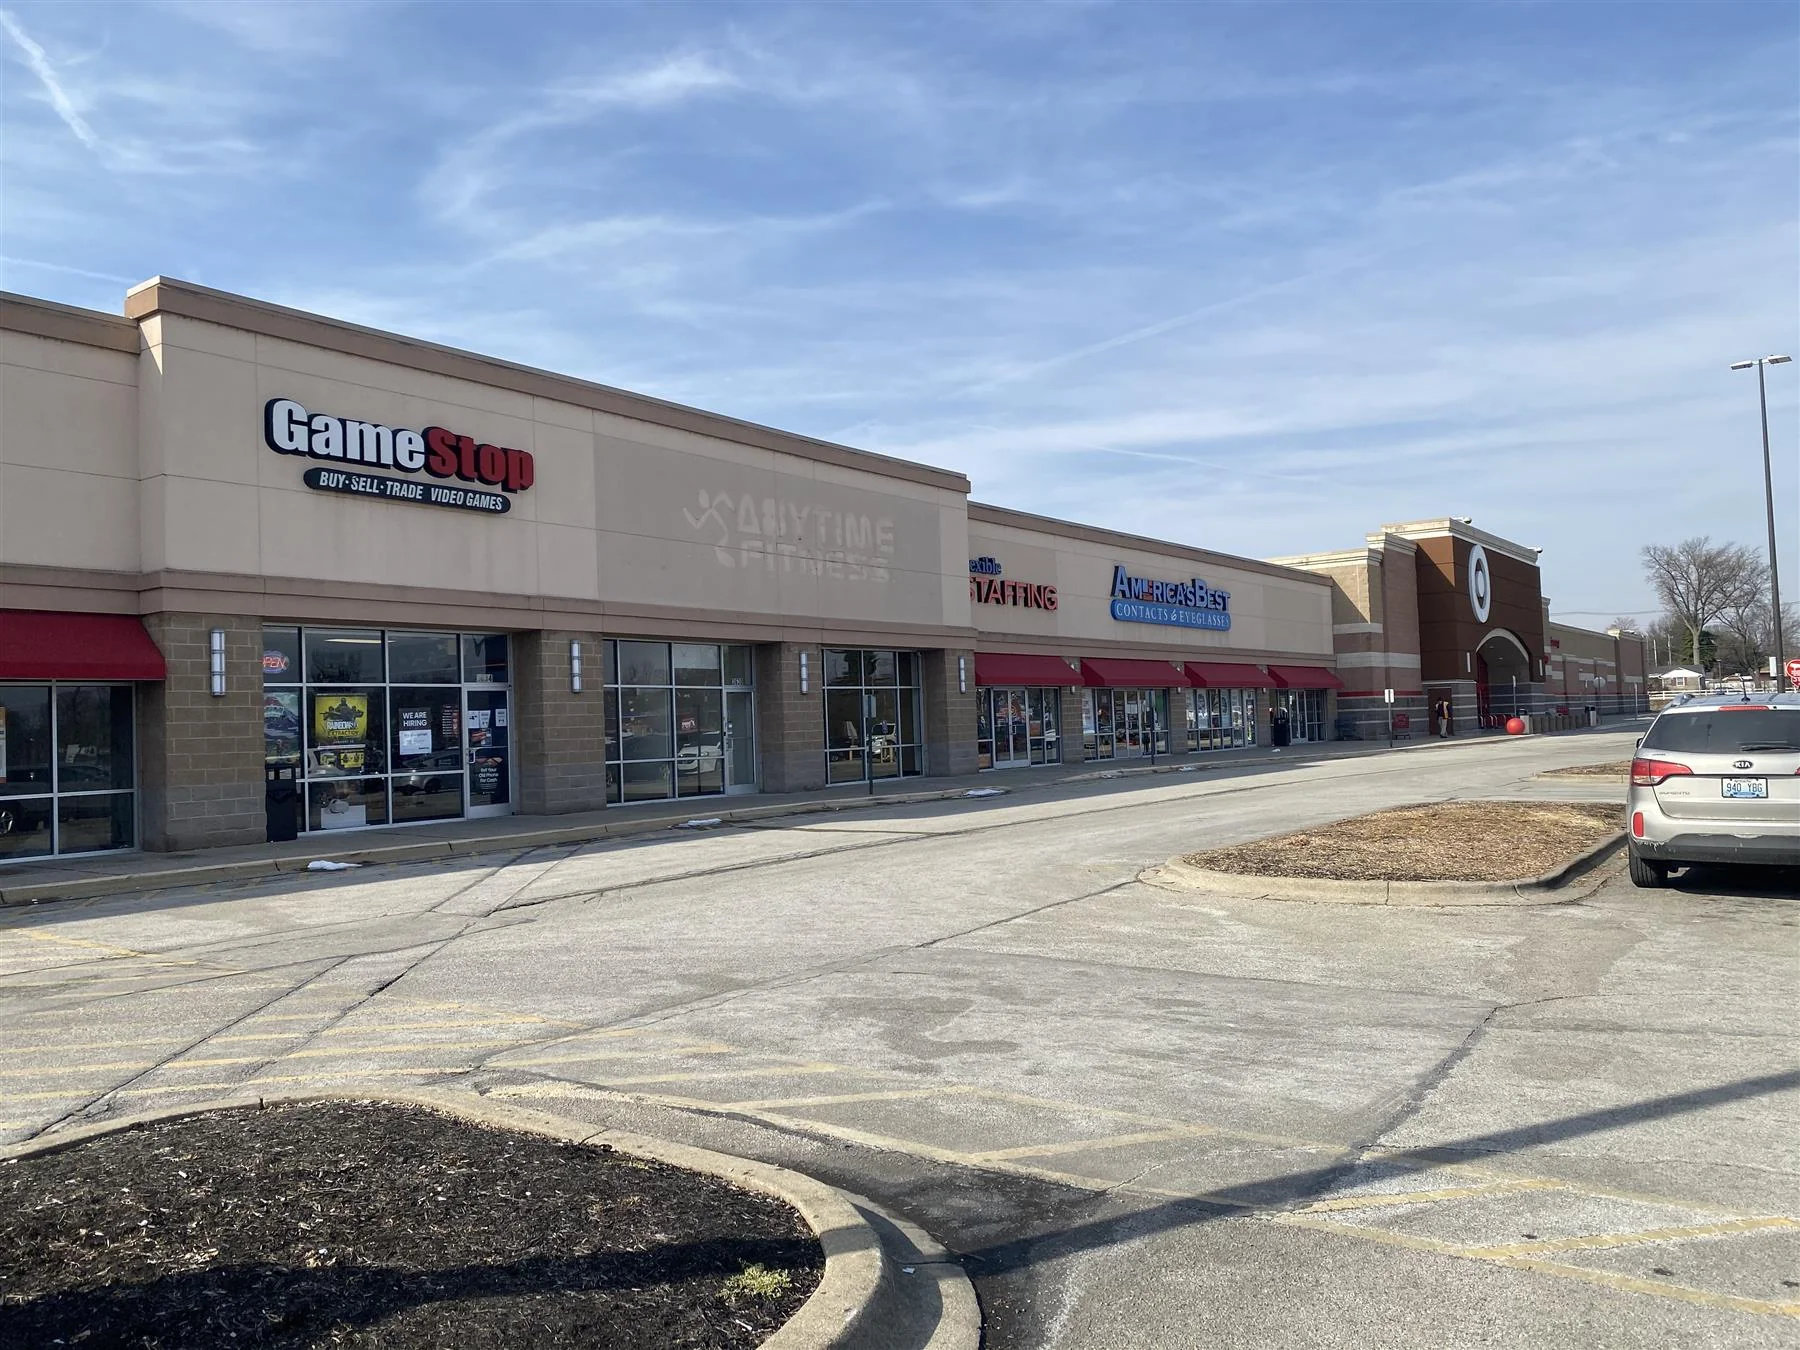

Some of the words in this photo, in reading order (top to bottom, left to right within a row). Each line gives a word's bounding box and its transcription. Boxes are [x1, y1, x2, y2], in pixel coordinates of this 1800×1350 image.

[264, 398, 534, 493] GameStop
[431, 487, 464, 505] VIDEO
[465, 492, 503, 511] GAMES
[1116, 603, 1168, 621] CONTACTS
[1179, 610, 1229, 627] EYEGLASSES
[263, 656, 287, 670] PEN
[414, 711, 427, 719] ARE
[403, 719, 427, 727] HIRING
[1734, 761, 1751, 769] KIA
[1726, 783, 1742, 792] 940
[1747, 783, 1763, 793] YBG
